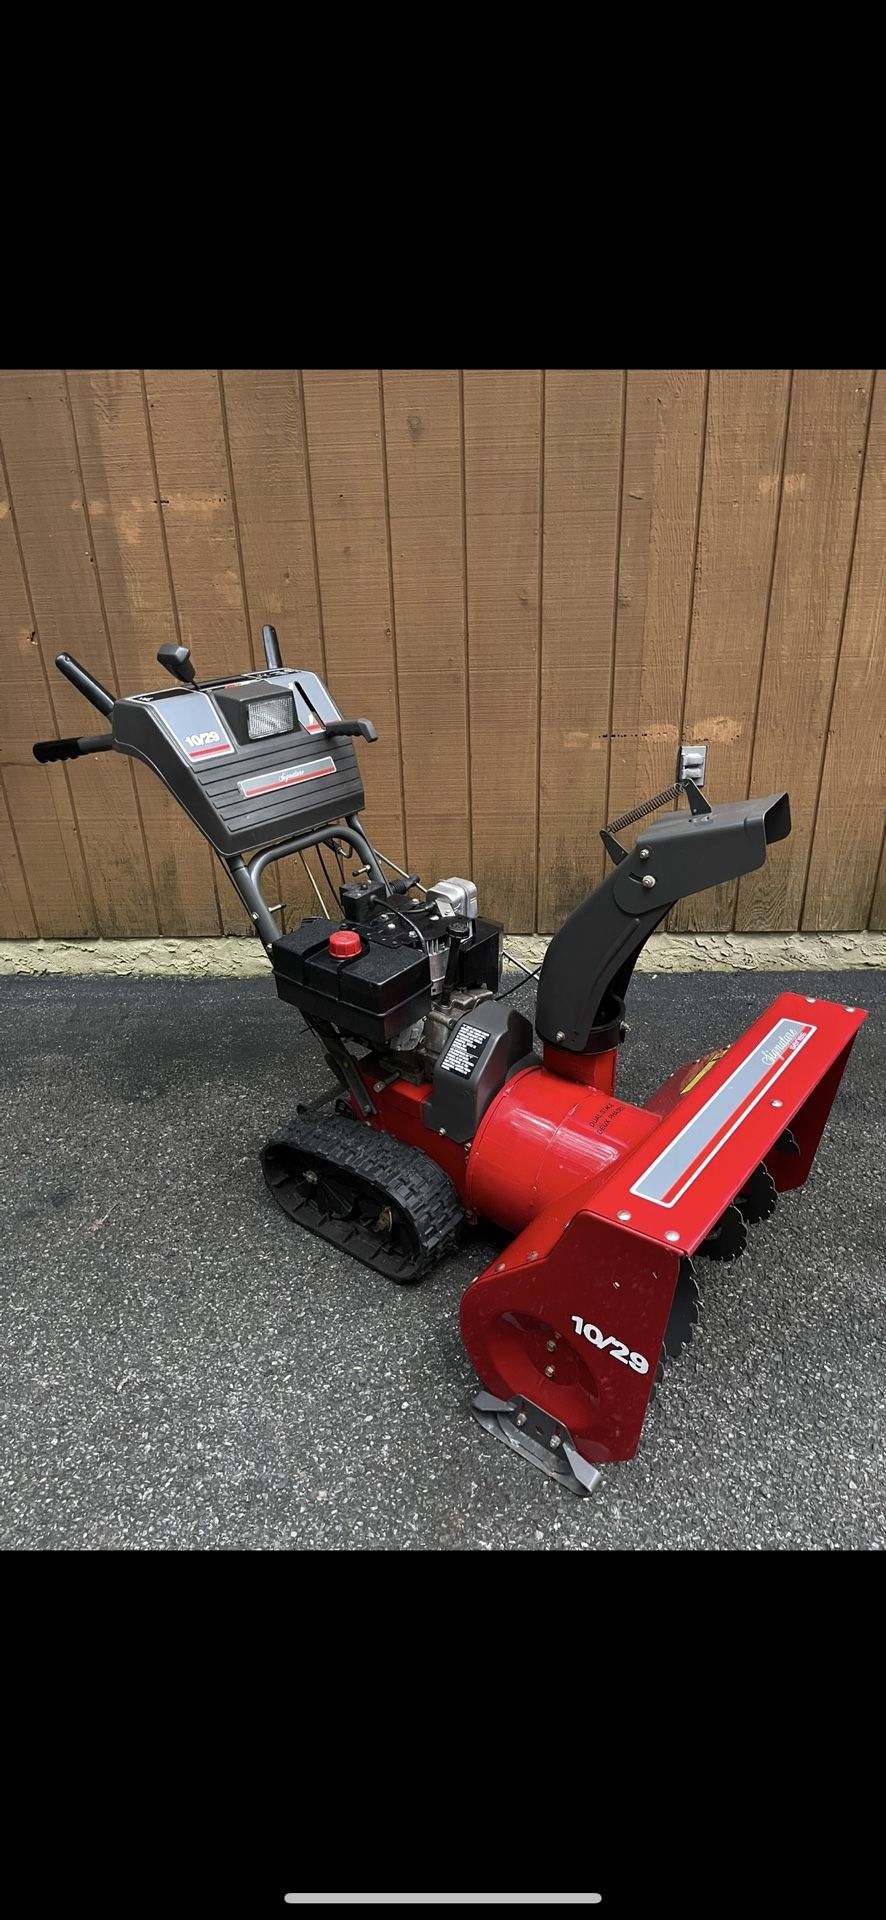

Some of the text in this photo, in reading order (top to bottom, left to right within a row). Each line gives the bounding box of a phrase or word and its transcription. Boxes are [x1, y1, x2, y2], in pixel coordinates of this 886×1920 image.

[185, 731, 220, 747] 10/29
[761, 1028, 797, 1066] Signature
[589, 1113, 602, 1128] DUAL
[597, 1119, 610, 1135] DEUX
[571, 1315, 650, 1375] 10/29
